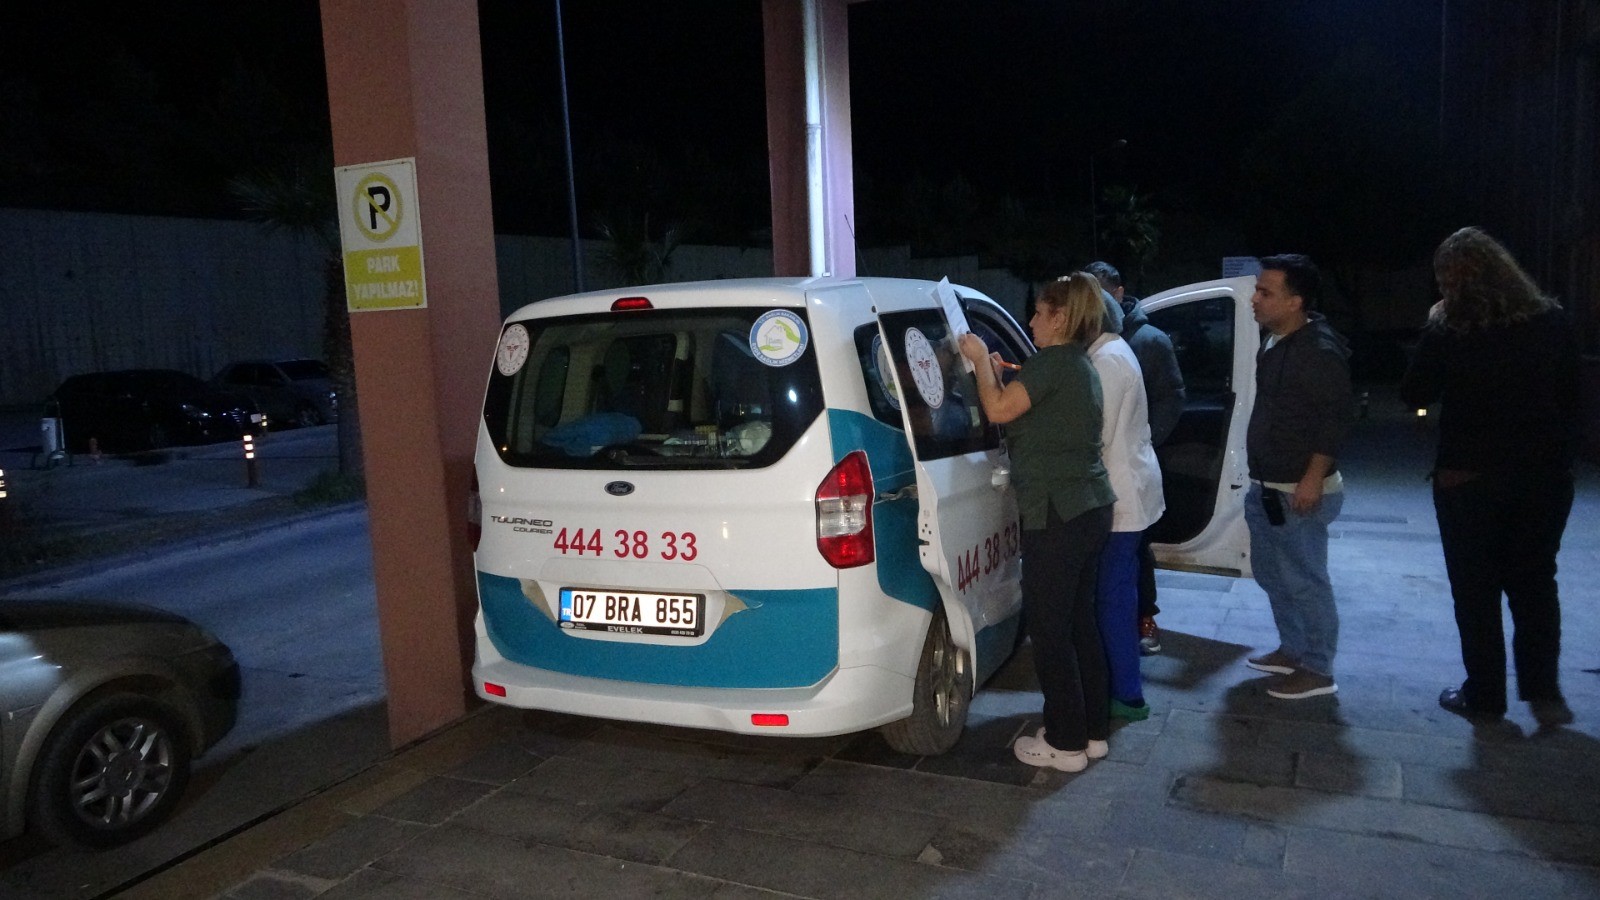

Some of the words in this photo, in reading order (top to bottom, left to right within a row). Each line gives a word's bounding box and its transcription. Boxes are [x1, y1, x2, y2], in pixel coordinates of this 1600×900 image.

[367, 254, 401, 274] PARK
[351, 280, 420, 300] YAPILMAZ!
[490, 515, 553, 527] TOURNEO
[513, 526, 553, 534] COURIER
[554, 527, 604, 557] 444
[614, 529, 649, 559] 38
[660, 531, 698, 561] 33
[957, 544, 980, 596] 444
[984, 532, 1000, 575] 38
[1003, 521, 1018, 562] 33
[562, 607, 572, 616] TR
[573, 594, 597, 619] 07
[605, 595, 642, 622] BRA
[656, 598, 694, 625] 855
[607, 625, 644, 634] EVELEK
